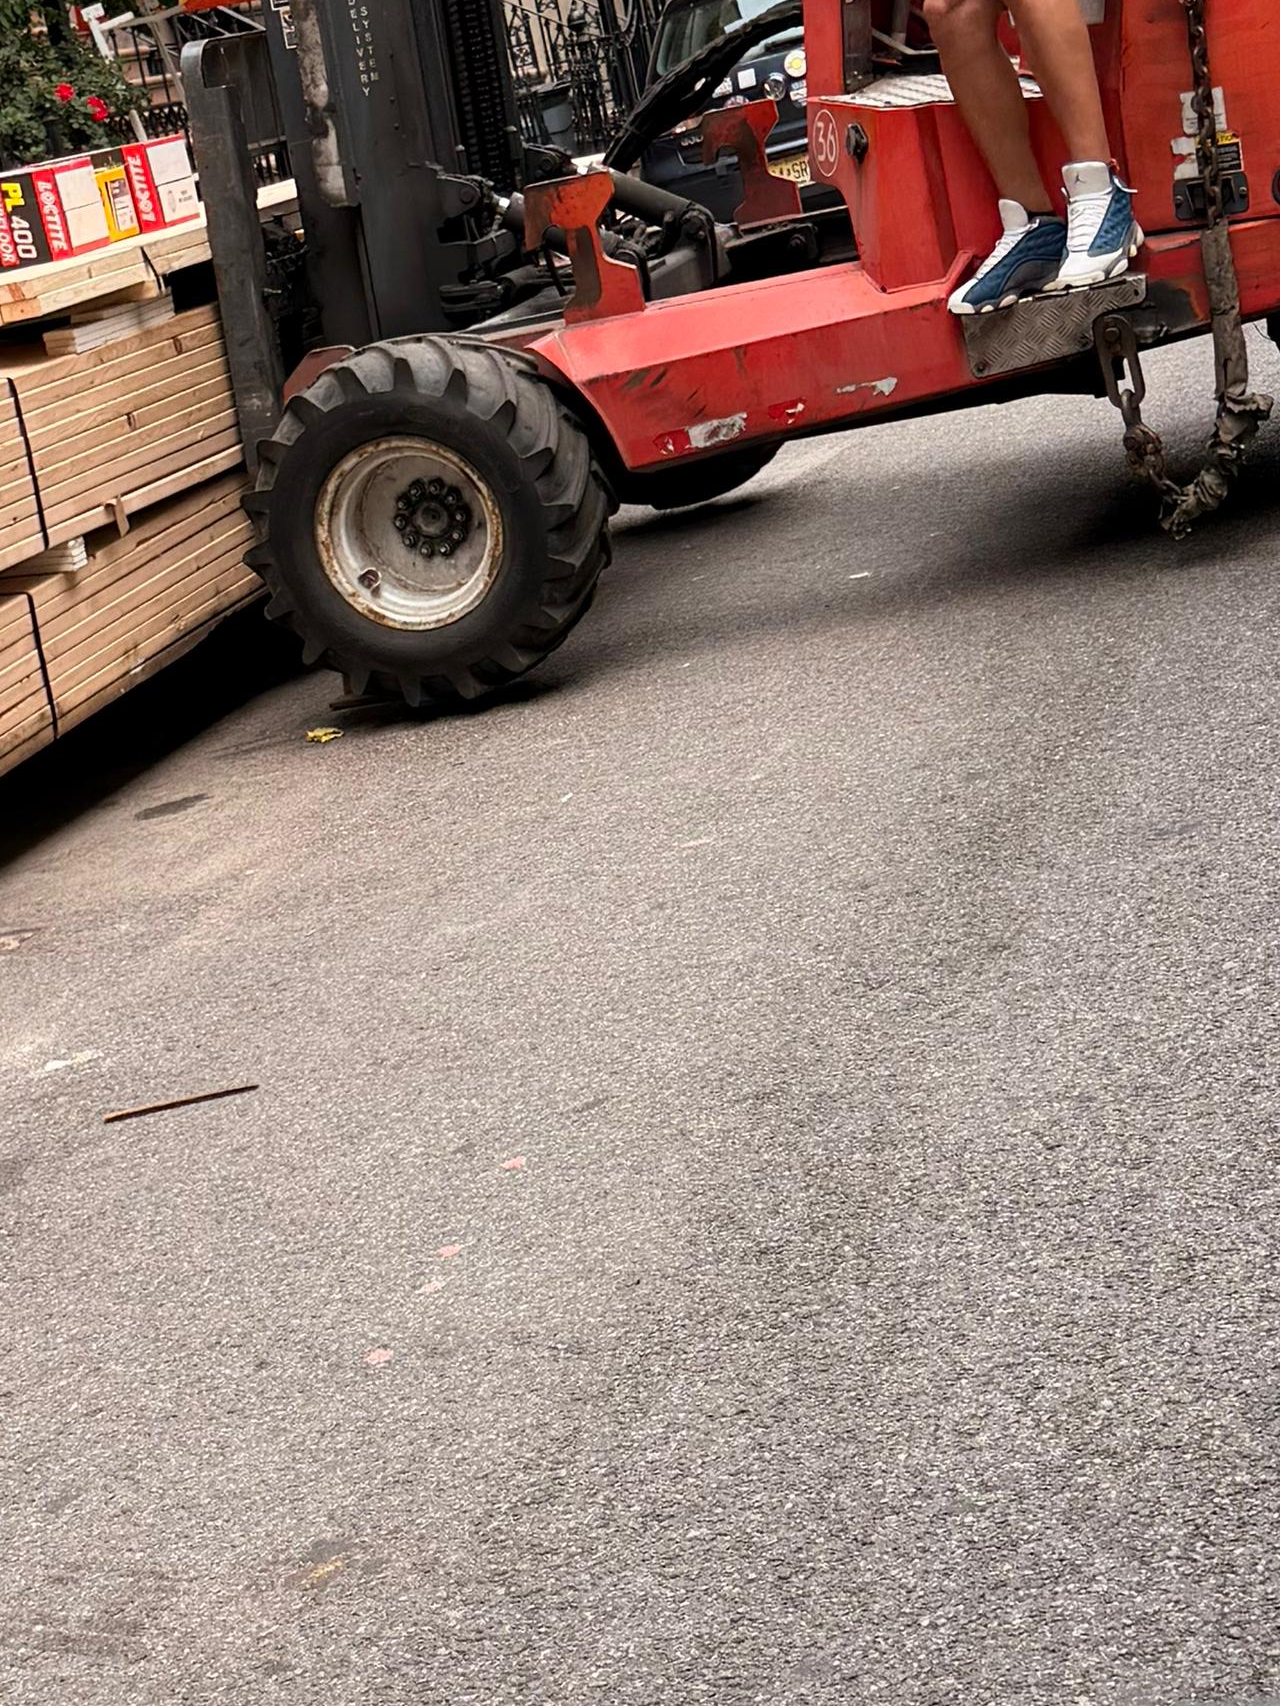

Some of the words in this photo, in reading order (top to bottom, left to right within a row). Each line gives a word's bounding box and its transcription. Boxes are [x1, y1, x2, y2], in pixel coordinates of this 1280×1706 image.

[359, 5, 380, 82] SYSTEM
[817, 122, 836, 162] 36
[0, 182, 26, 214] PL
[36, 180, 69, 251] LOCTITE
[127, 154, 157, 223] LOCTITE
[10, 215, 38, 260] 400
